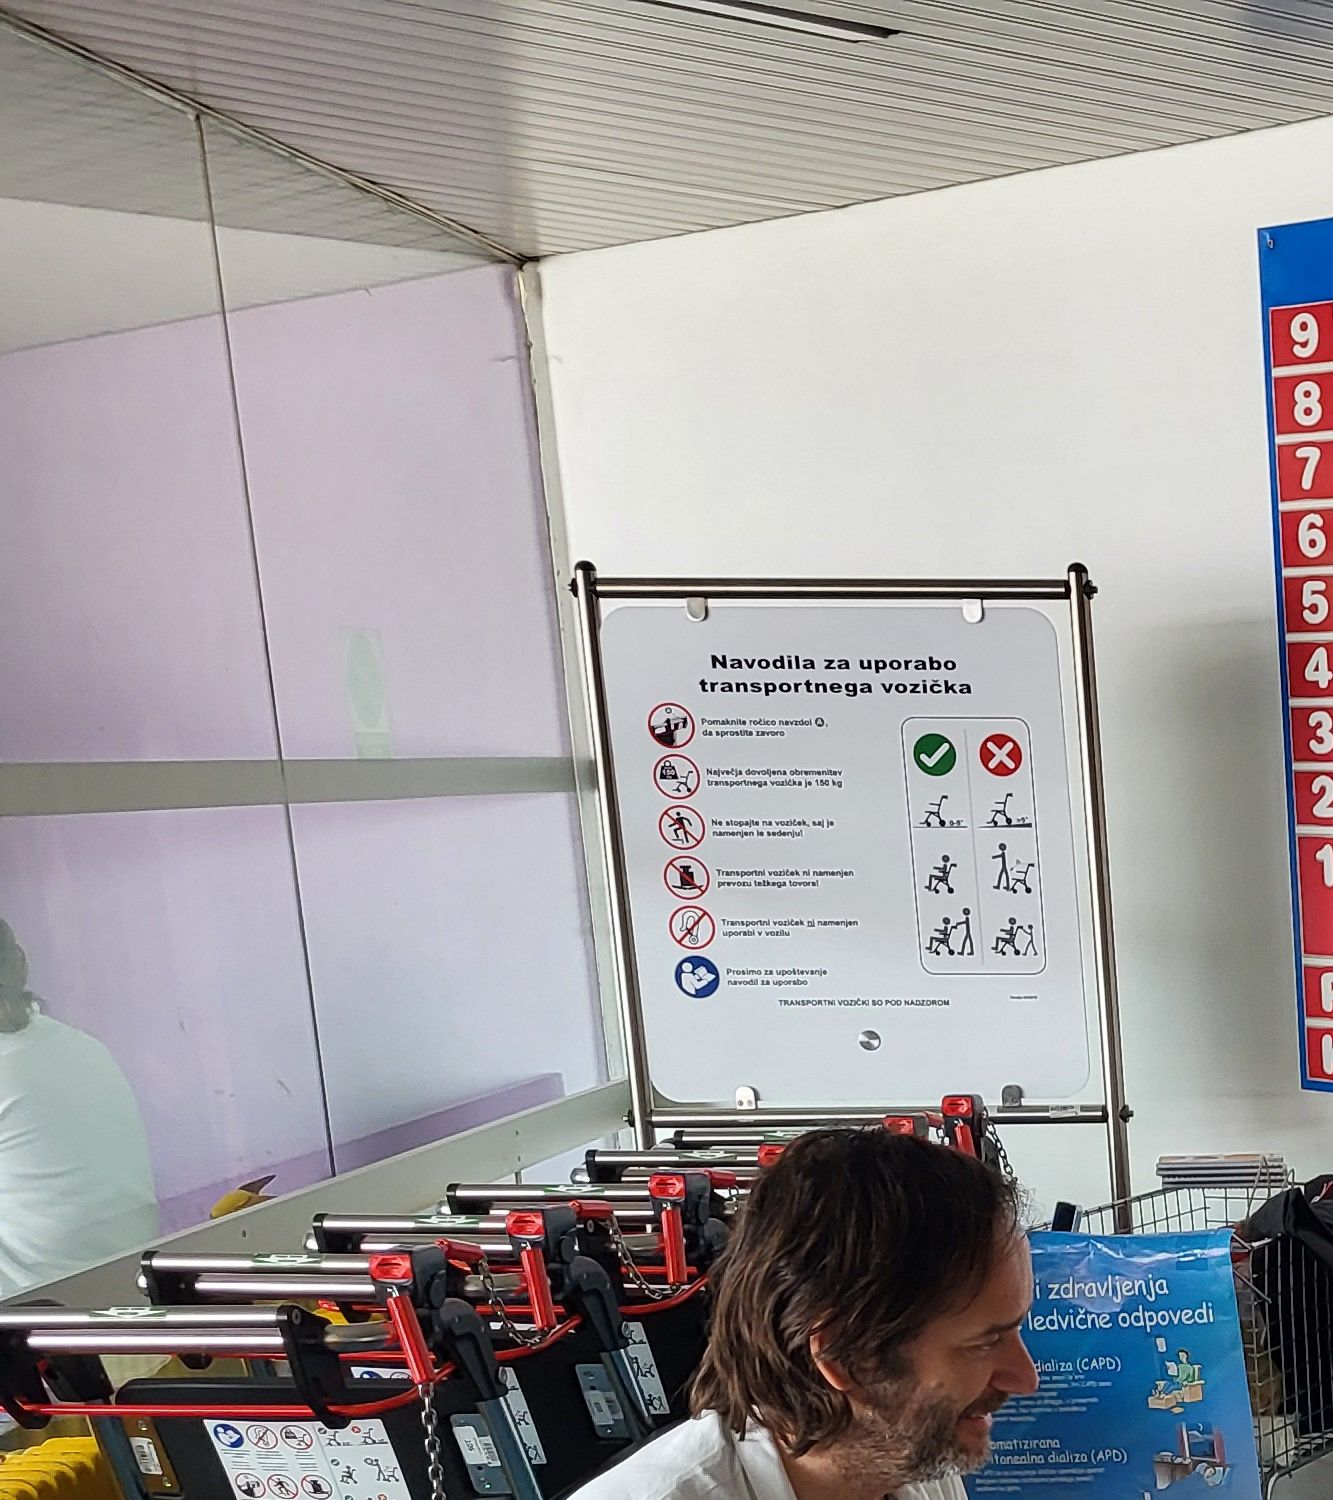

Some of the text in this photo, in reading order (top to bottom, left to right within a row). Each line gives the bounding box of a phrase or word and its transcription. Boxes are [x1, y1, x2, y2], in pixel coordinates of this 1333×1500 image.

[1290, 313, 1319, 358] 9
[1293, 381, 1322, 426] 8
[1295, 447, 1321, 490] 7
[1298, 513, 1327, 558] 6
[1301, 581, 1329, 625] 5
[711, 655, 956, 673] Navodila za uporabo
[1304, 646, 1333, 689] 4
[700, 678, 972, 697] transportnega vozička
[701, 718, 746, 726] Pomaknite
[779, 718, 812, 726] navzdol
[778, 997, 950, 1007] TRANSPORTNI VOZIČKI SO POD NADZOROM
[1048, 1274, 1168, 1303] zdravljenja
[1028, 1302, 1214, 1332] ledvične odpovedi
[1077, 1356, 1121, 1372] (CAPD)
[1048, 1449, 1127, 1464] dializa (APD)
